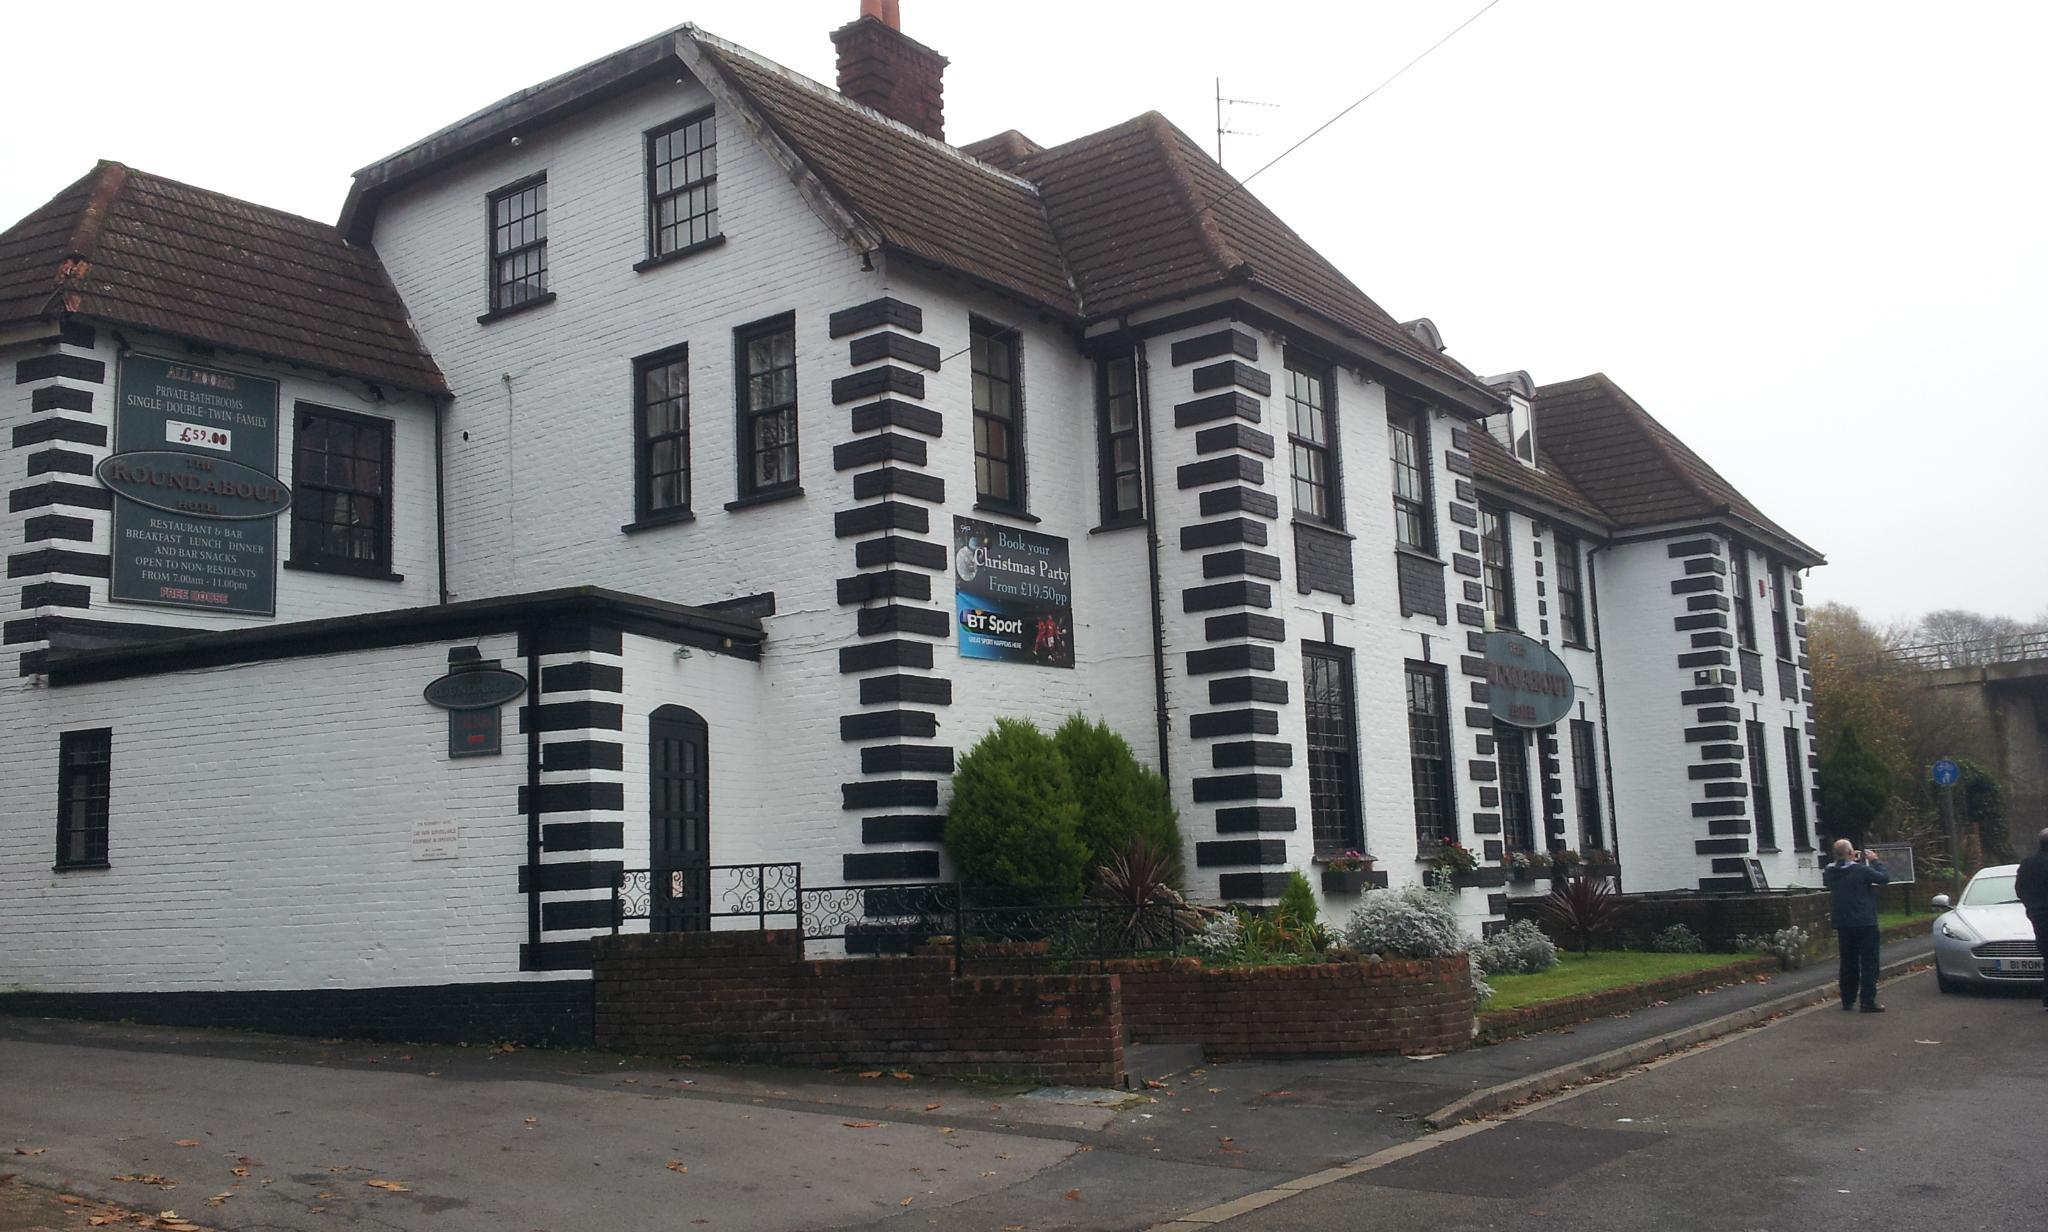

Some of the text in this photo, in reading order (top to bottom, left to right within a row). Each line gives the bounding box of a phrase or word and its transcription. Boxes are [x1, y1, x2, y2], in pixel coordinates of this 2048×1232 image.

[155, 385, 190, 401] PRIVATE
[127, 394, 268, 428] SINGLE DOUBLE TWIN FAMILY
[180, 427, 227, 445] £59.00
[111, 463, 280, 502] ROUNDABOUT
[150, 519, 243, 538] RESTAURANT & BAR
[126, 529, 264, 554] BREAKFAST LUNCH DINNER
[999, 531, 1050, 556] Book your
[135, 557, 162, 567] OPEN
[165, 560, 179, 569] TO
[155, 546, 237, 563] AND BAR SNACKS
[141, 570, 170, 581] FROM
[974, 547, 1069, 586] Christmas Party
[989, 576, 1067, 606] From £19.50pp
[967, 614, 1022, 634] BT Sport
